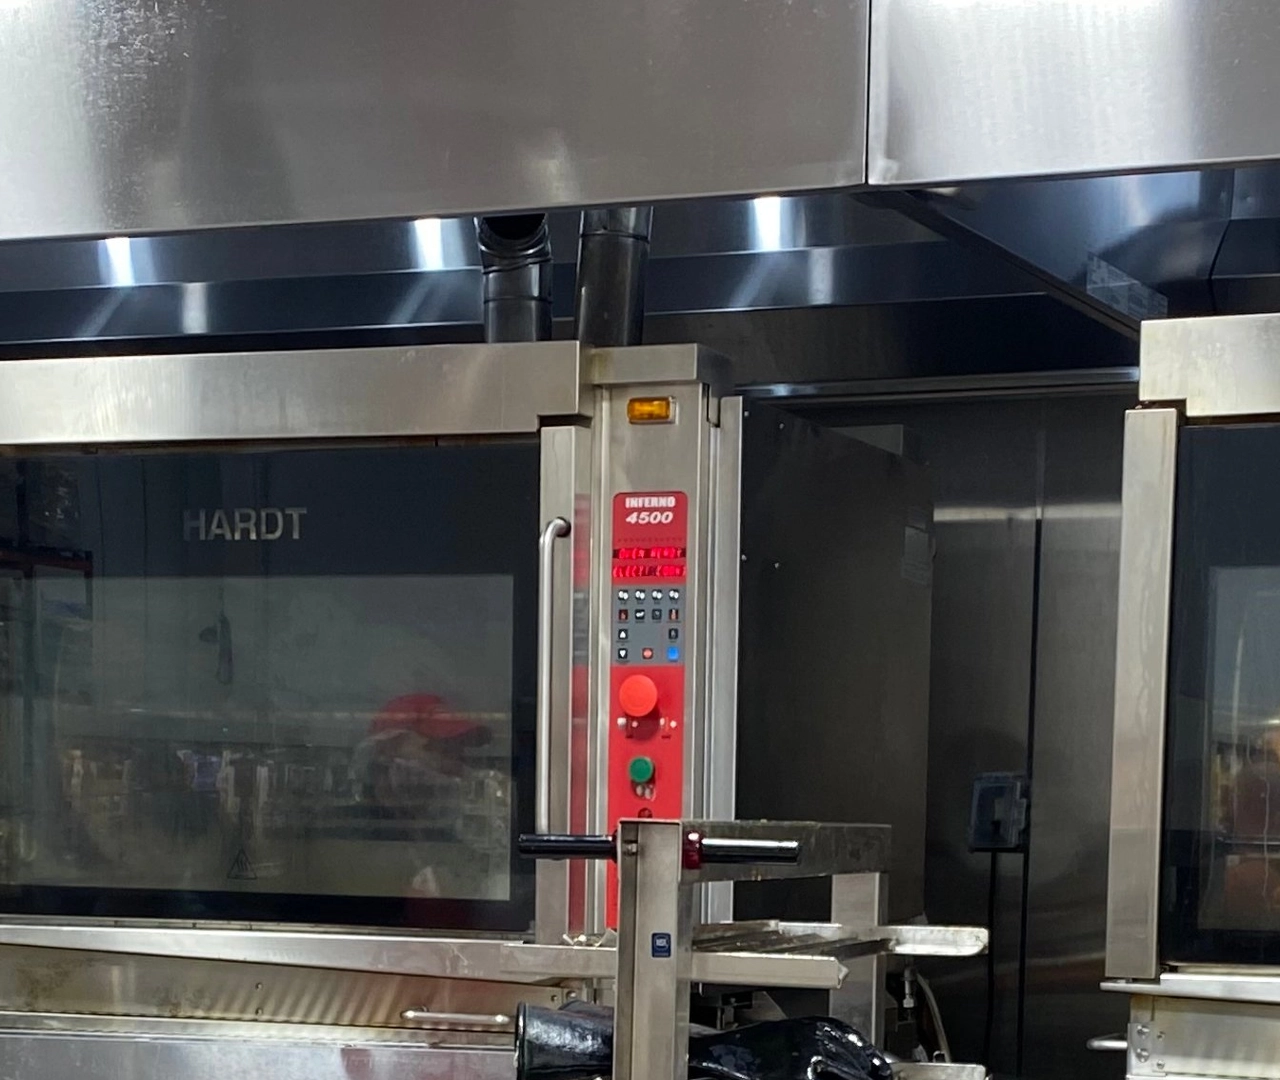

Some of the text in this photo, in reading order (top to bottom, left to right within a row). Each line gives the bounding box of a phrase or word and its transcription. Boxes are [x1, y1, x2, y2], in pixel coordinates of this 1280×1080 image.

[625, 496, 676, 508] INFERNO
[183, 507, 308, 541] HARDT
[625, 511, 674, 525] 4500
